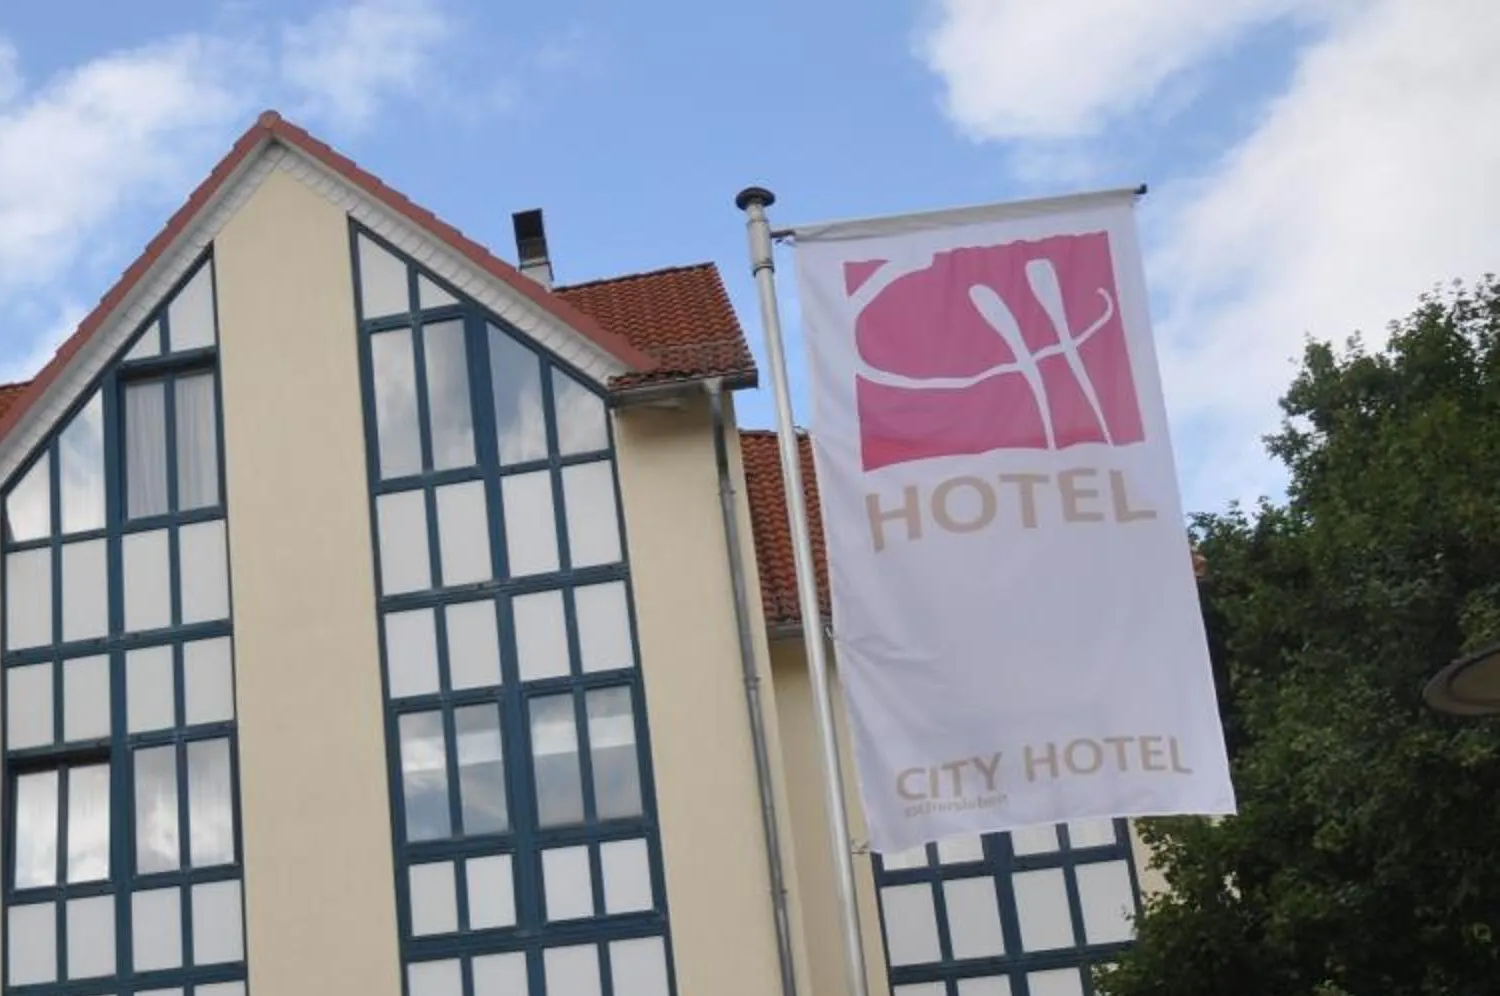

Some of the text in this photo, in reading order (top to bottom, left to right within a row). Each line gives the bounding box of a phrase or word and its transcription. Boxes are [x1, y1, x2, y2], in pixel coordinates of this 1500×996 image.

[865, 468, 1157, 553] HOTEL
[896, 735, 1193, 801] CITY HOTEL
